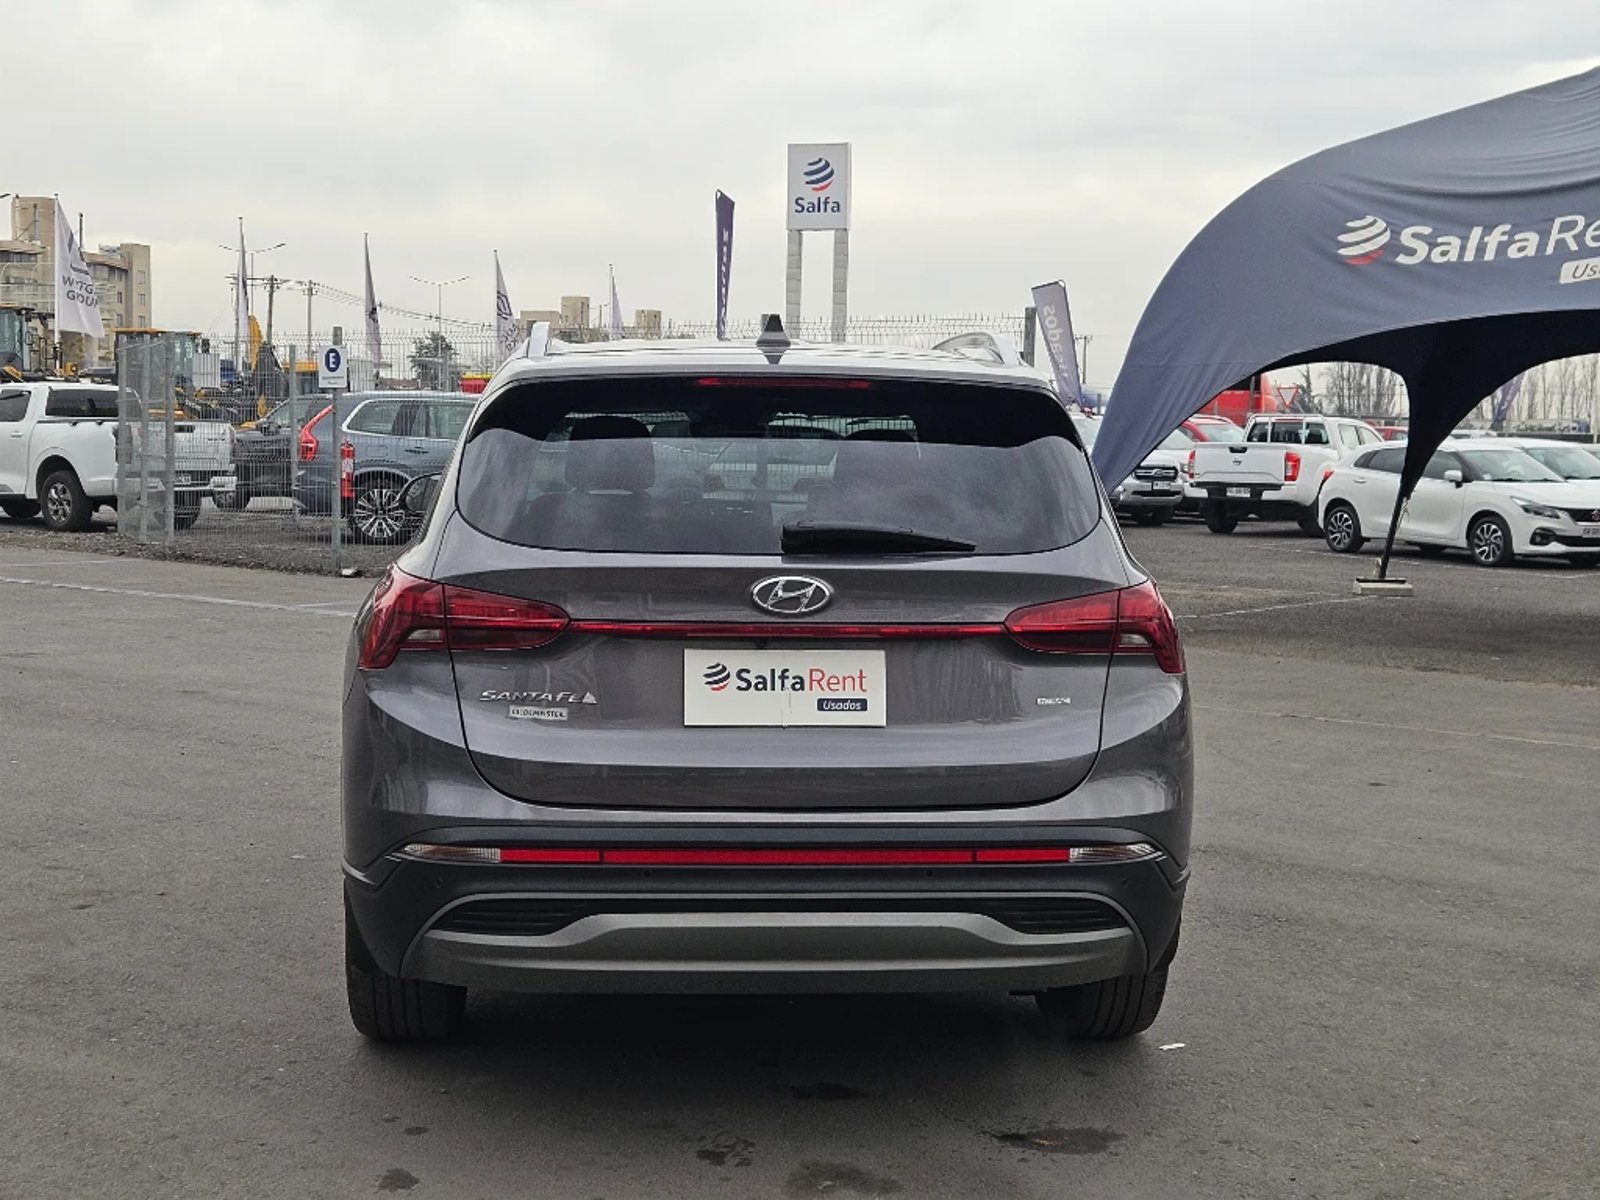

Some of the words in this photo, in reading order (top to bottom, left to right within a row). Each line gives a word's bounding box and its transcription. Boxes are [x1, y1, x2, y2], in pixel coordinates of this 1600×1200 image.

[794, 196, 841, 214] Salfa
[1572, 264, 1600, 279] Us
[329, 352, 337, 368] E
[480, 690, 553, 702] SANTA
[822, 698, 862, 711] Usados
